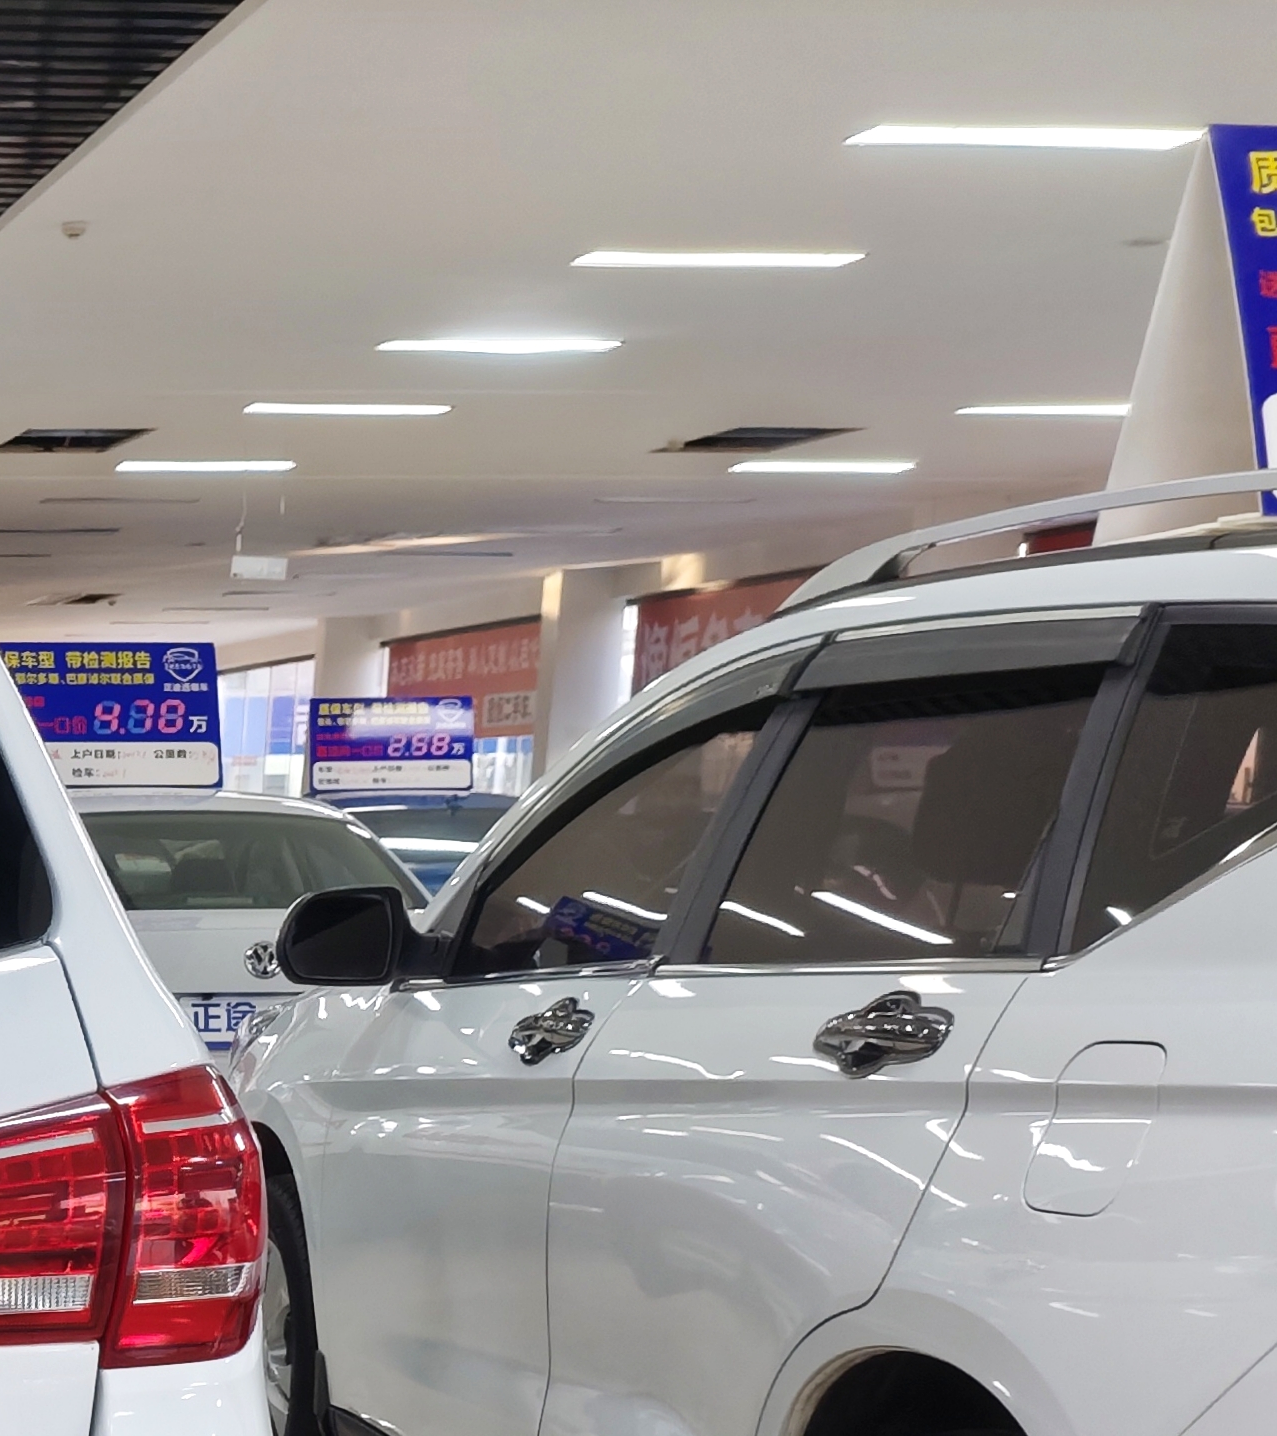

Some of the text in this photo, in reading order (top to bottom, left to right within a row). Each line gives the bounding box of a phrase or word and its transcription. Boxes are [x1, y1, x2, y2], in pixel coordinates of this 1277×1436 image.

[65, 651, 152, 669] 带检测报告
